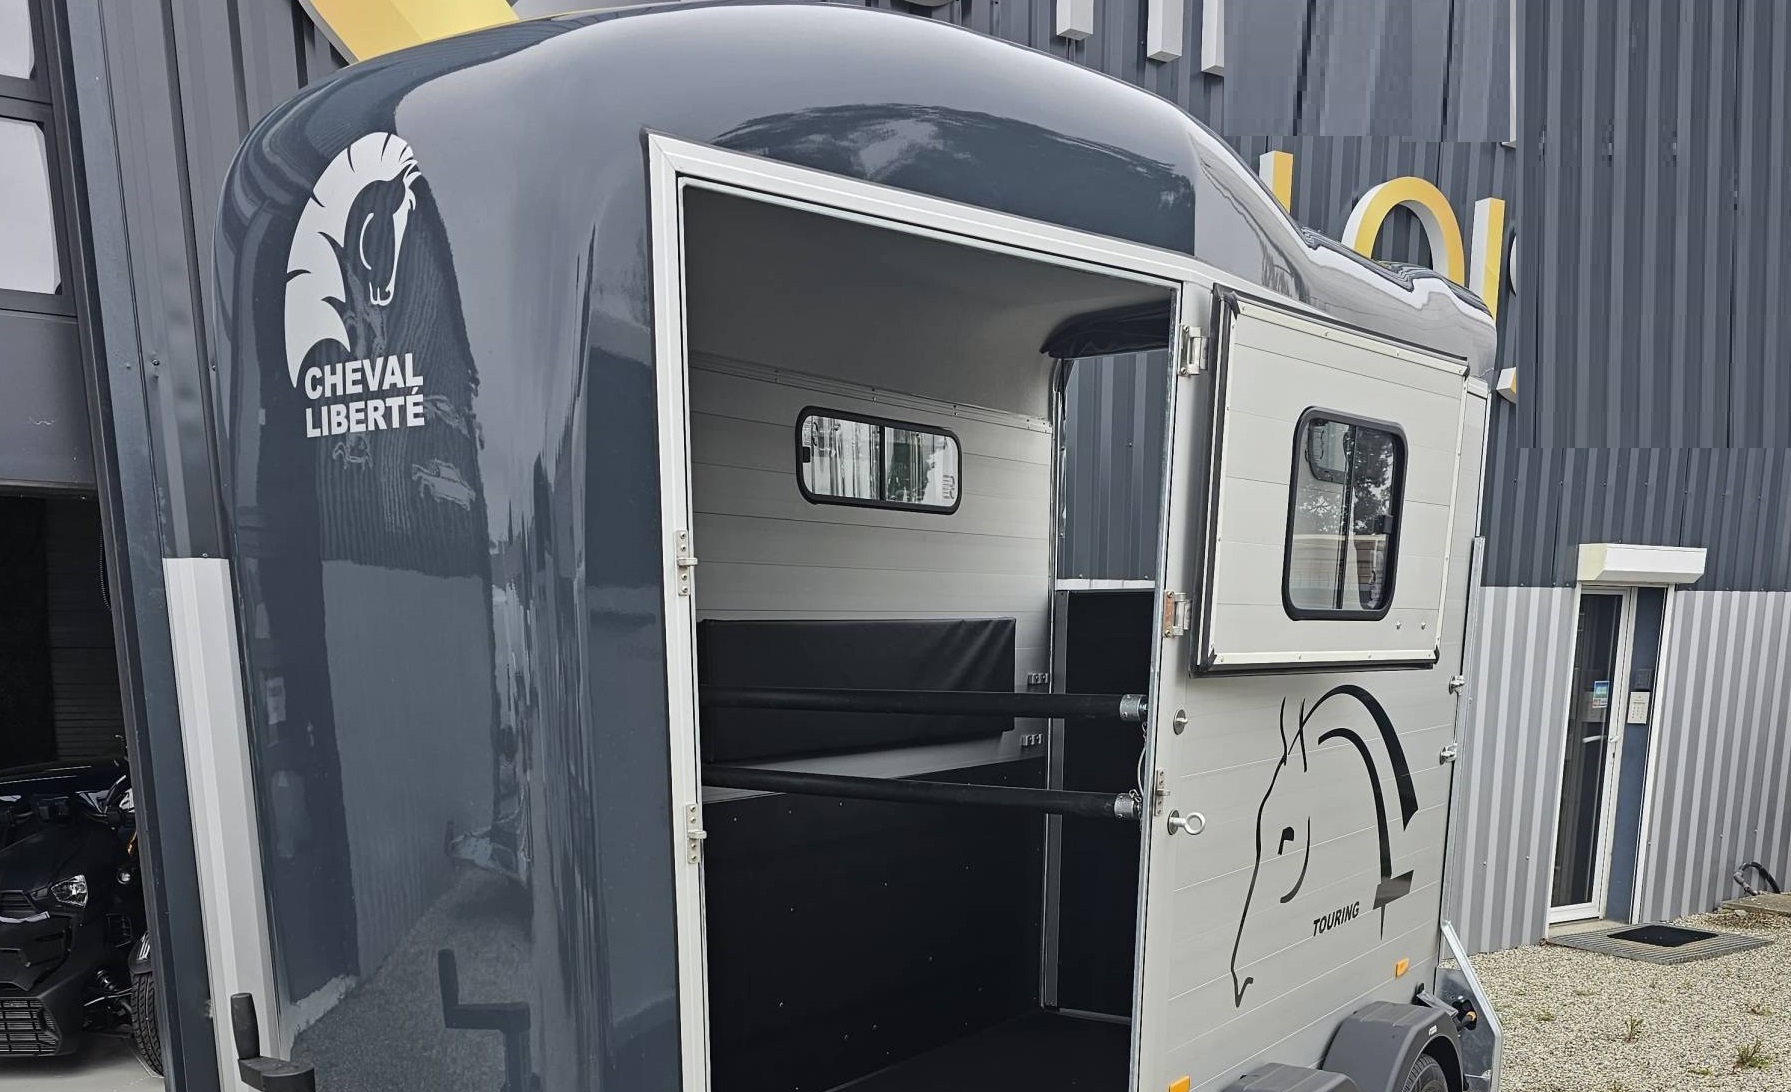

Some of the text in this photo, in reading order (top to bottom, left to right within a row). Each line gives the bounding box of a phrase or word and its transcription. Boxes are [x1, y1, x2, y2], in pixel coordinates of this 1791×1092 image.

[304, 352, 424, 400] CHEVAL
[305, 386, 425, 438] LIBERTÉ
[1313, 900, 1360, 937] TOURING
